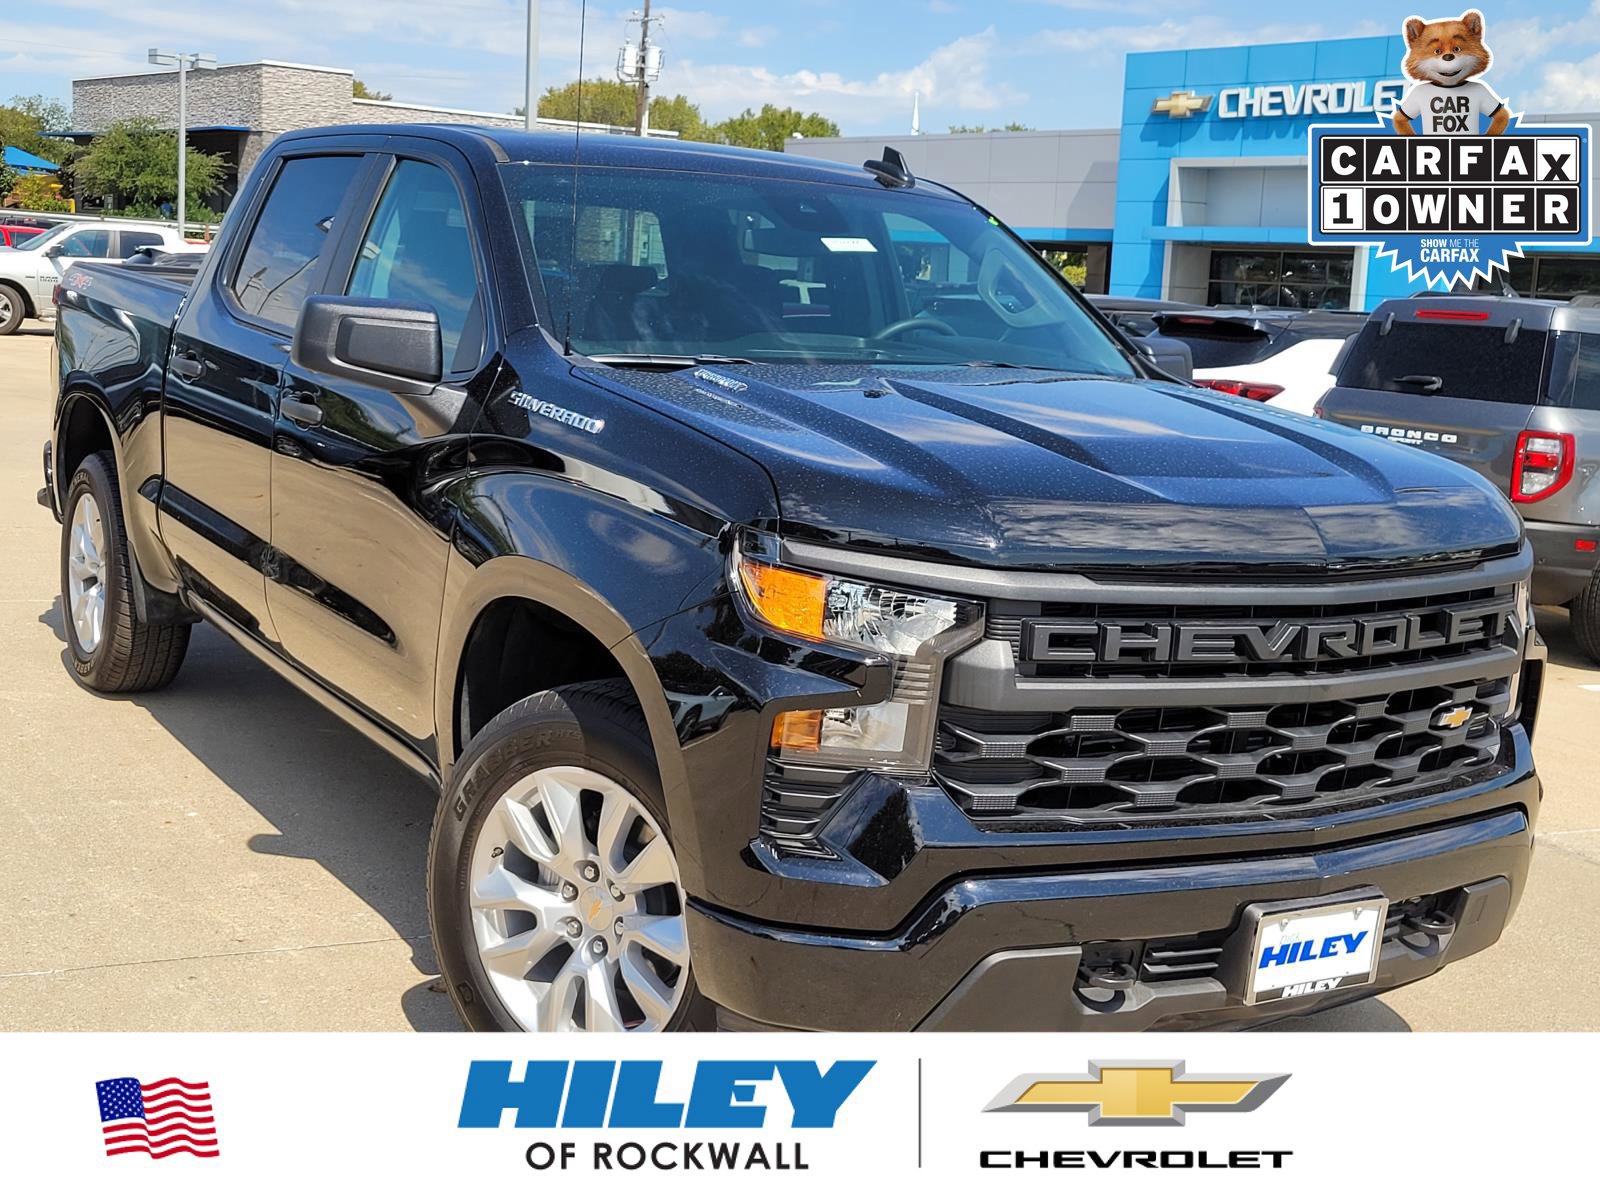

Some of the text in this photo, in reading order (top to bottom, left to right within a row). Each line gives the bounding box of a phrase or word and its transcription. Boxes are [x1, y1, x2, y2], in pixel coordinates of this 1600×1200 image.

[507, 390, 605, 434] SILVERADO
[1360, 424, 1458, 443] BRONCO
[1019, 600, 1516, 662] CHEVROLET
[1258, 931, 1368, 969] HILEY
[1282, 977, 1343, 999] HILEY
